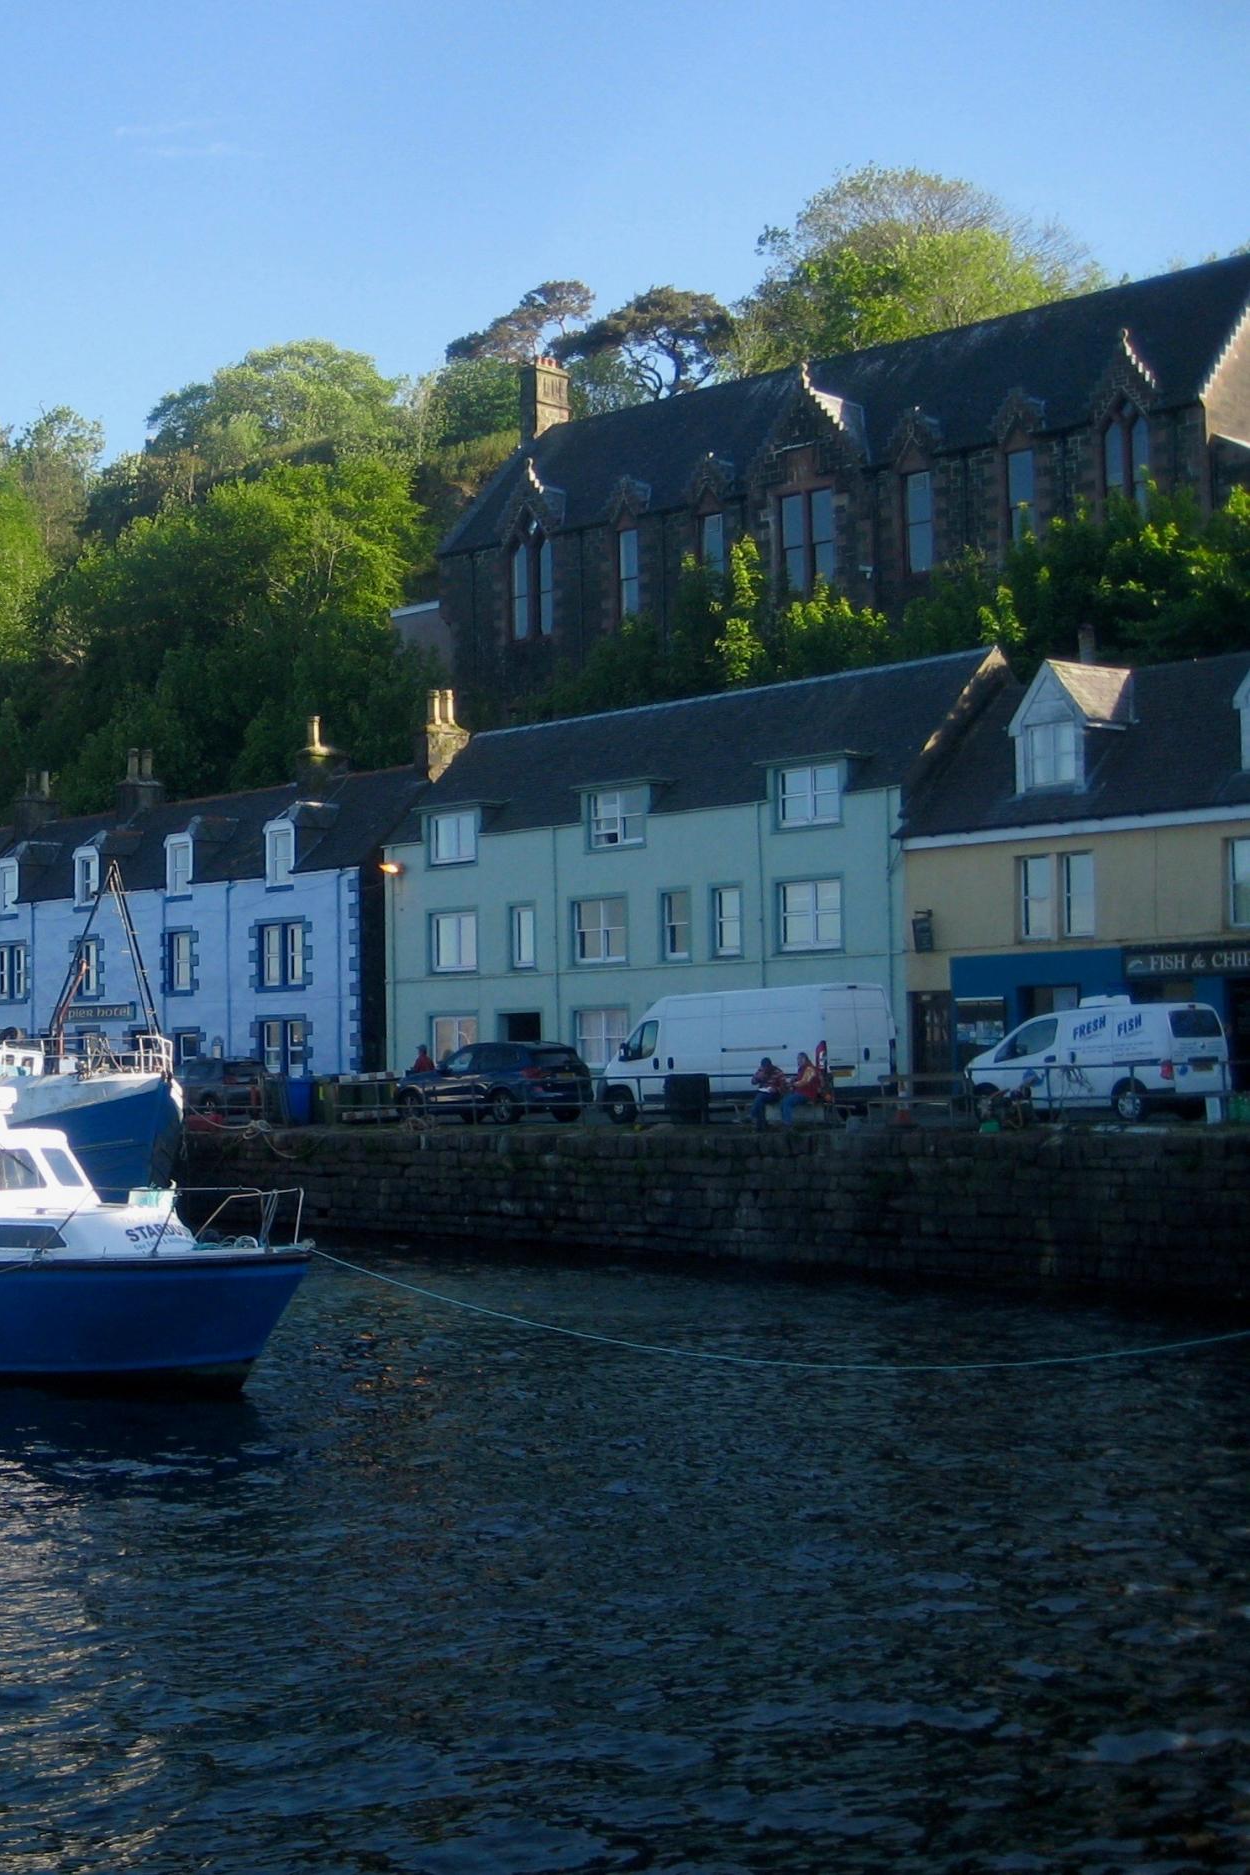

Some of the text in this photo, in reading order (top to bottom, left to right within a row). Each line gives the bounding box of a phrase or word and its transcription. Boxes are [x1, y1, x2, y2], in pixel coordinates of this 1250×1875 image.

[1150, 954, 1186, 971] FISH
[1191, 953, 1206, 969] &
[97, 1006, 130, 1017] hotel
[1073, 1014, 1142, 1040] FRESH FISH
